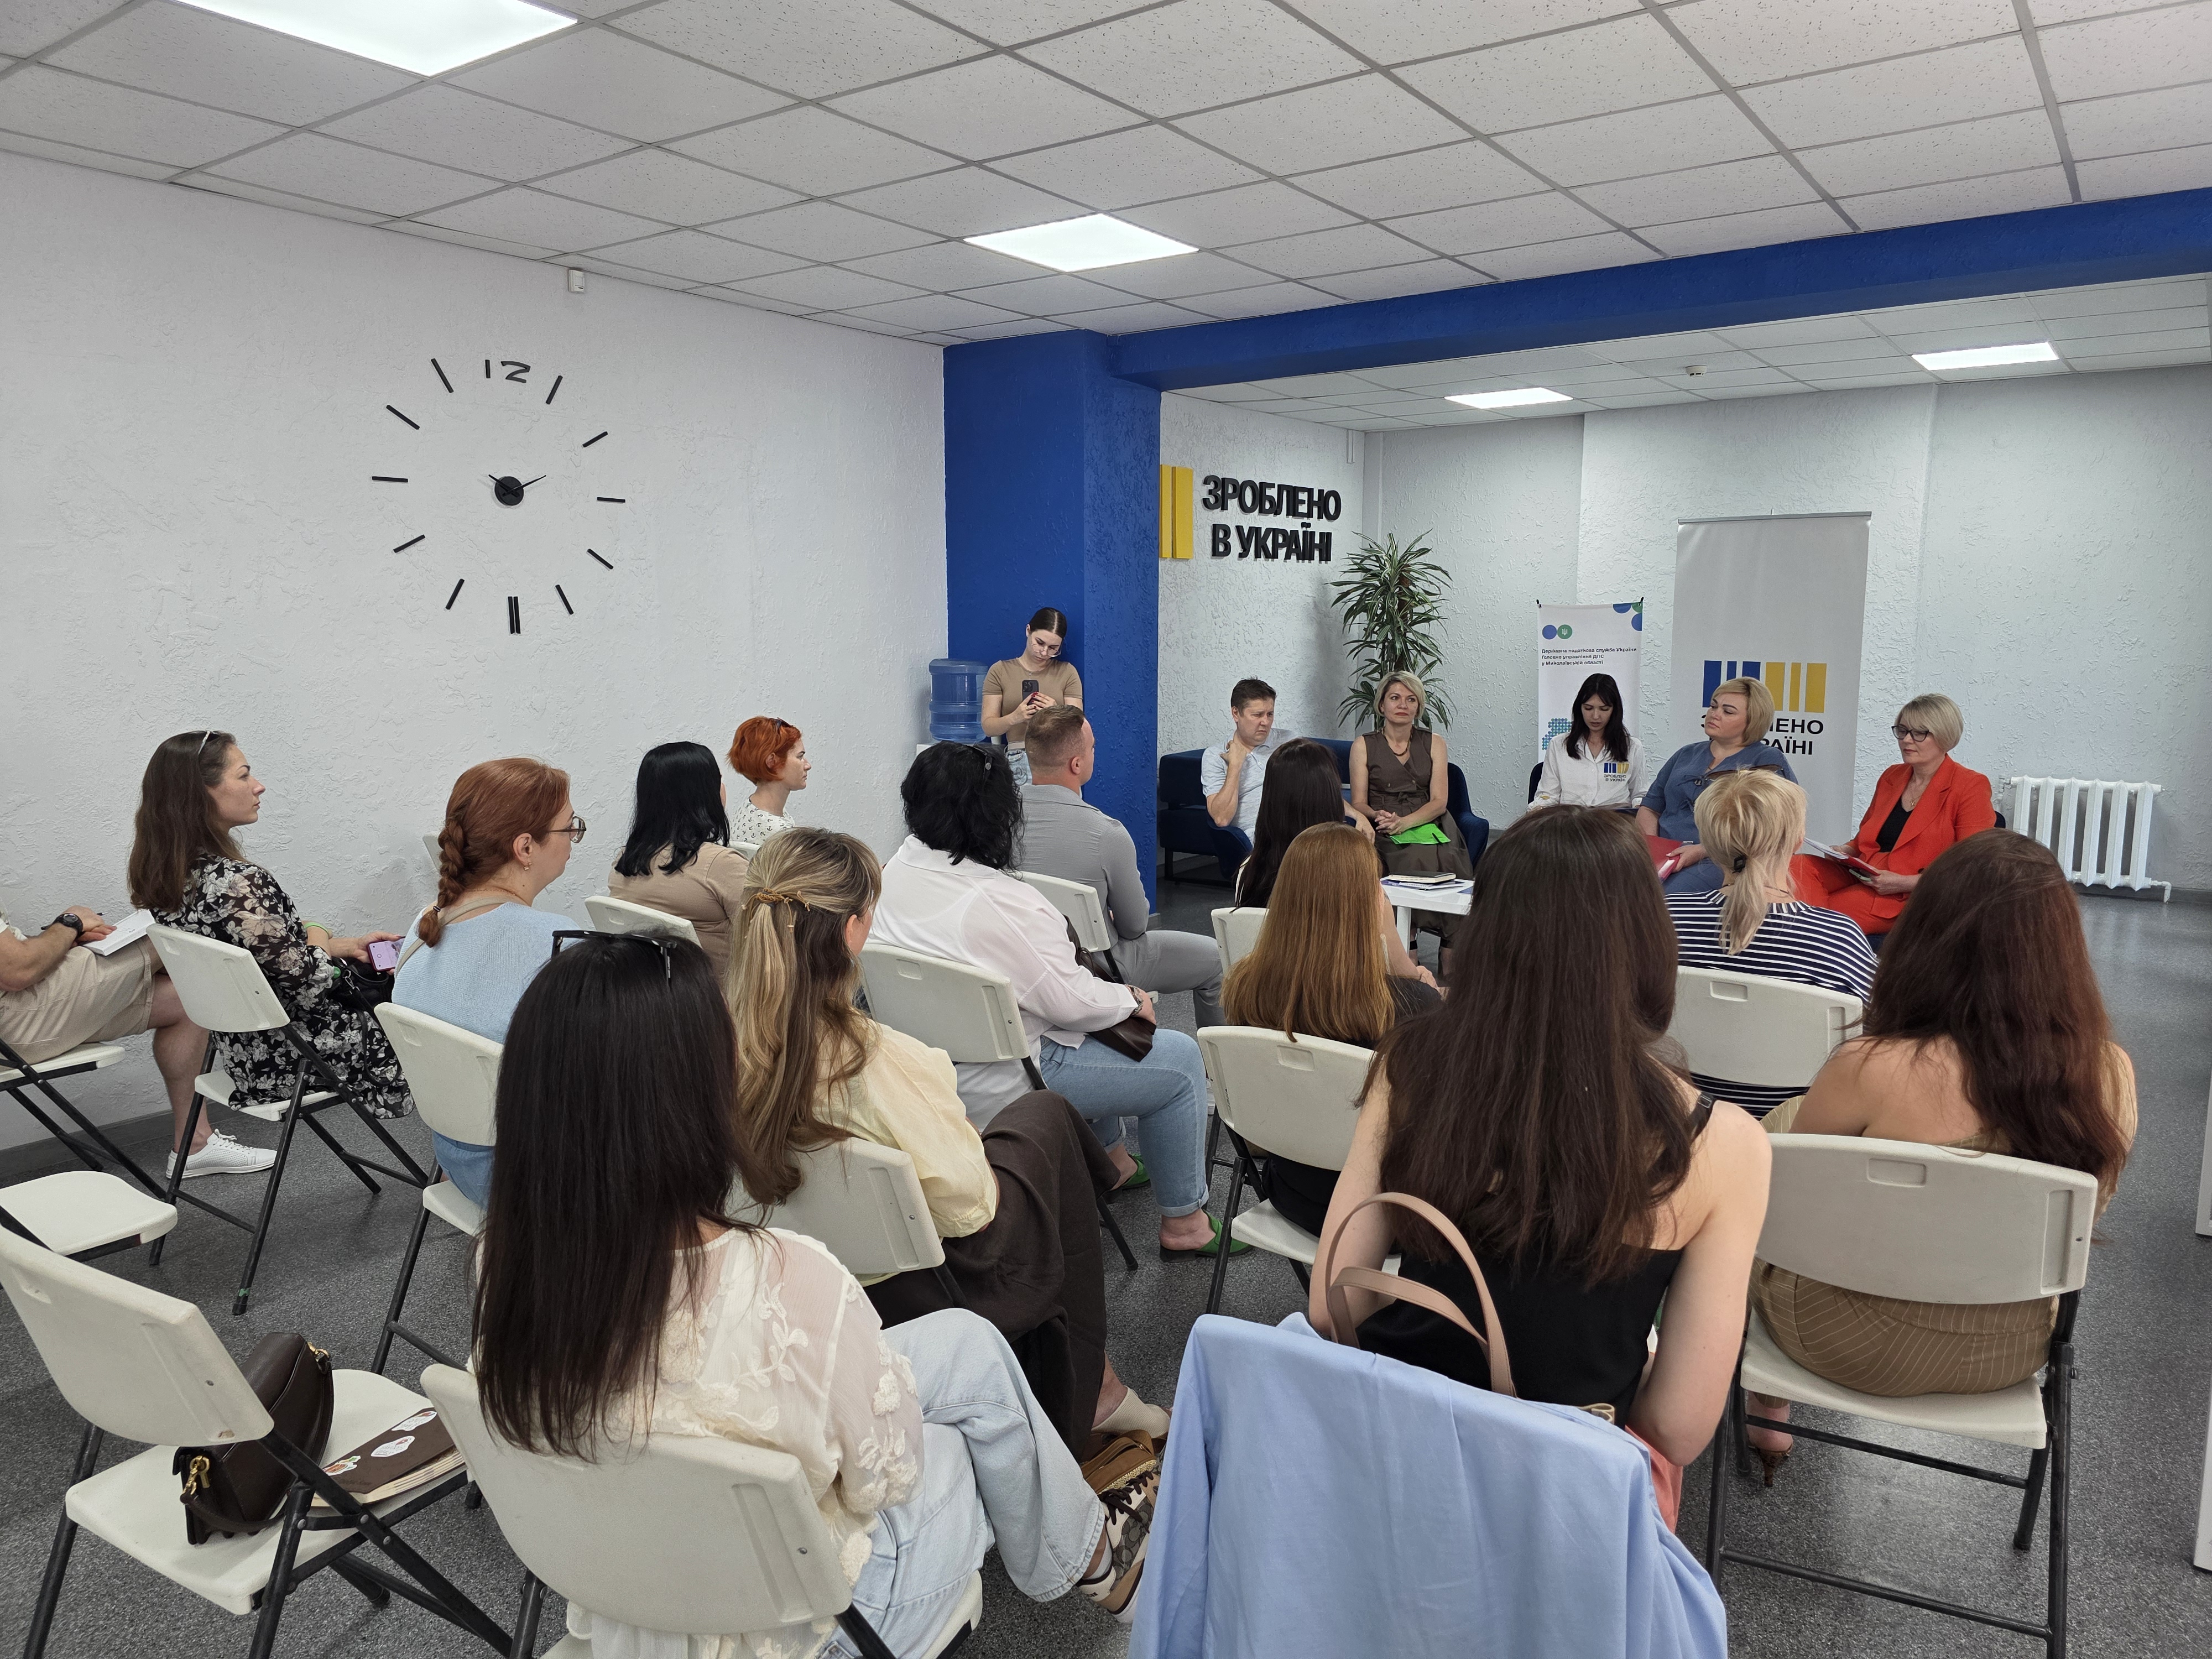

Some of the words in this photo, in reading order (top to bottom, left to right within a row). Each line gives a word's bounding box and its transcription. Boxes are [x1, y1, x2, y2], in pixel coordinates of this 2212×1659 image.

[484, 359, 531, 383] 12
[1202, 475, 1342, 521] ЗРОБЛЕНО
[1212, 523, 1232, 557] В
[1235, 521, 1332, 562] УКРАЇНІ
